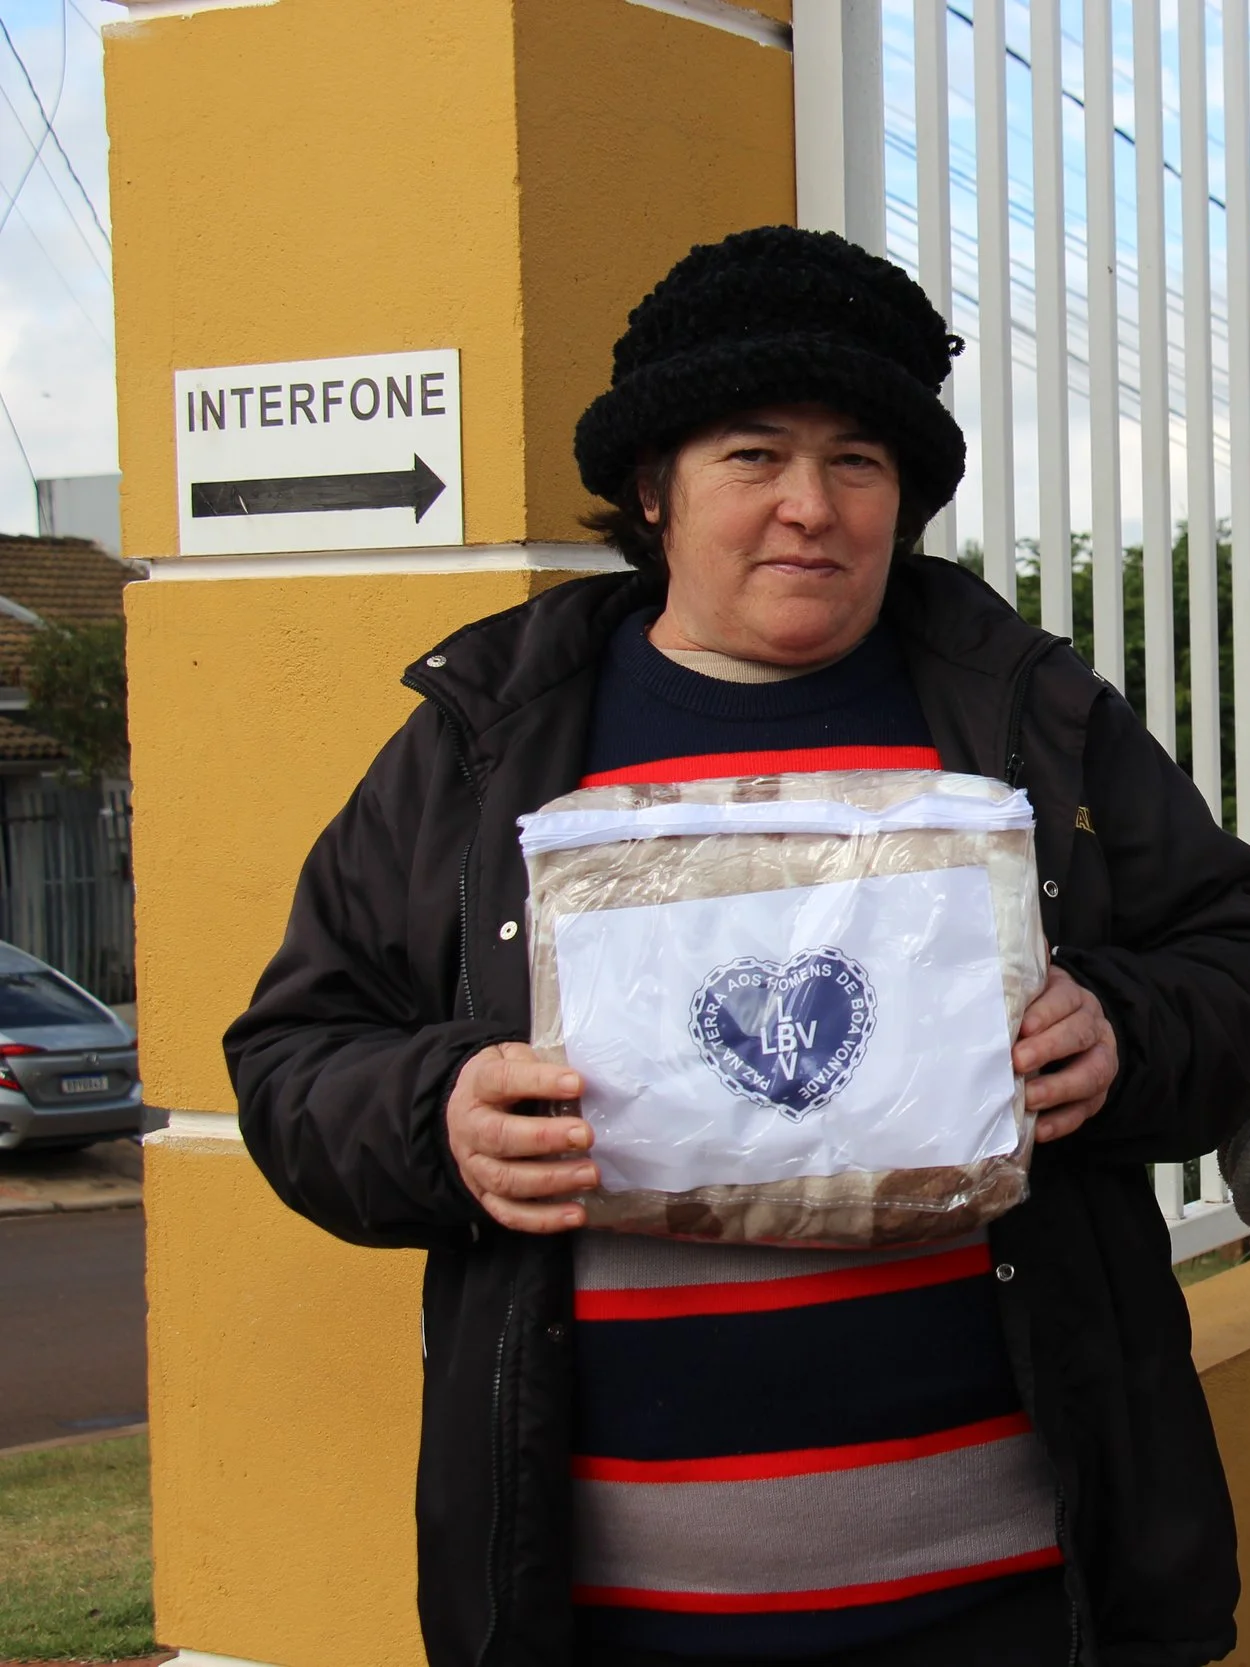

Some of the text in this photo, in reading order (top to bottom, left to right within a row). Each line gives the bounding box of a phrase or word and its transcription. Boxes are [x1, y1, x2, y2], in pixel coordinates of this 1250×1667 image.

[187, 371, 446, 432] INTERFONE
[704, 964, 864, 1100] PAZ NA TERRA AOS HOMENS DE BOA VONTADE
[760, 1020, 818, 1055] LBV
